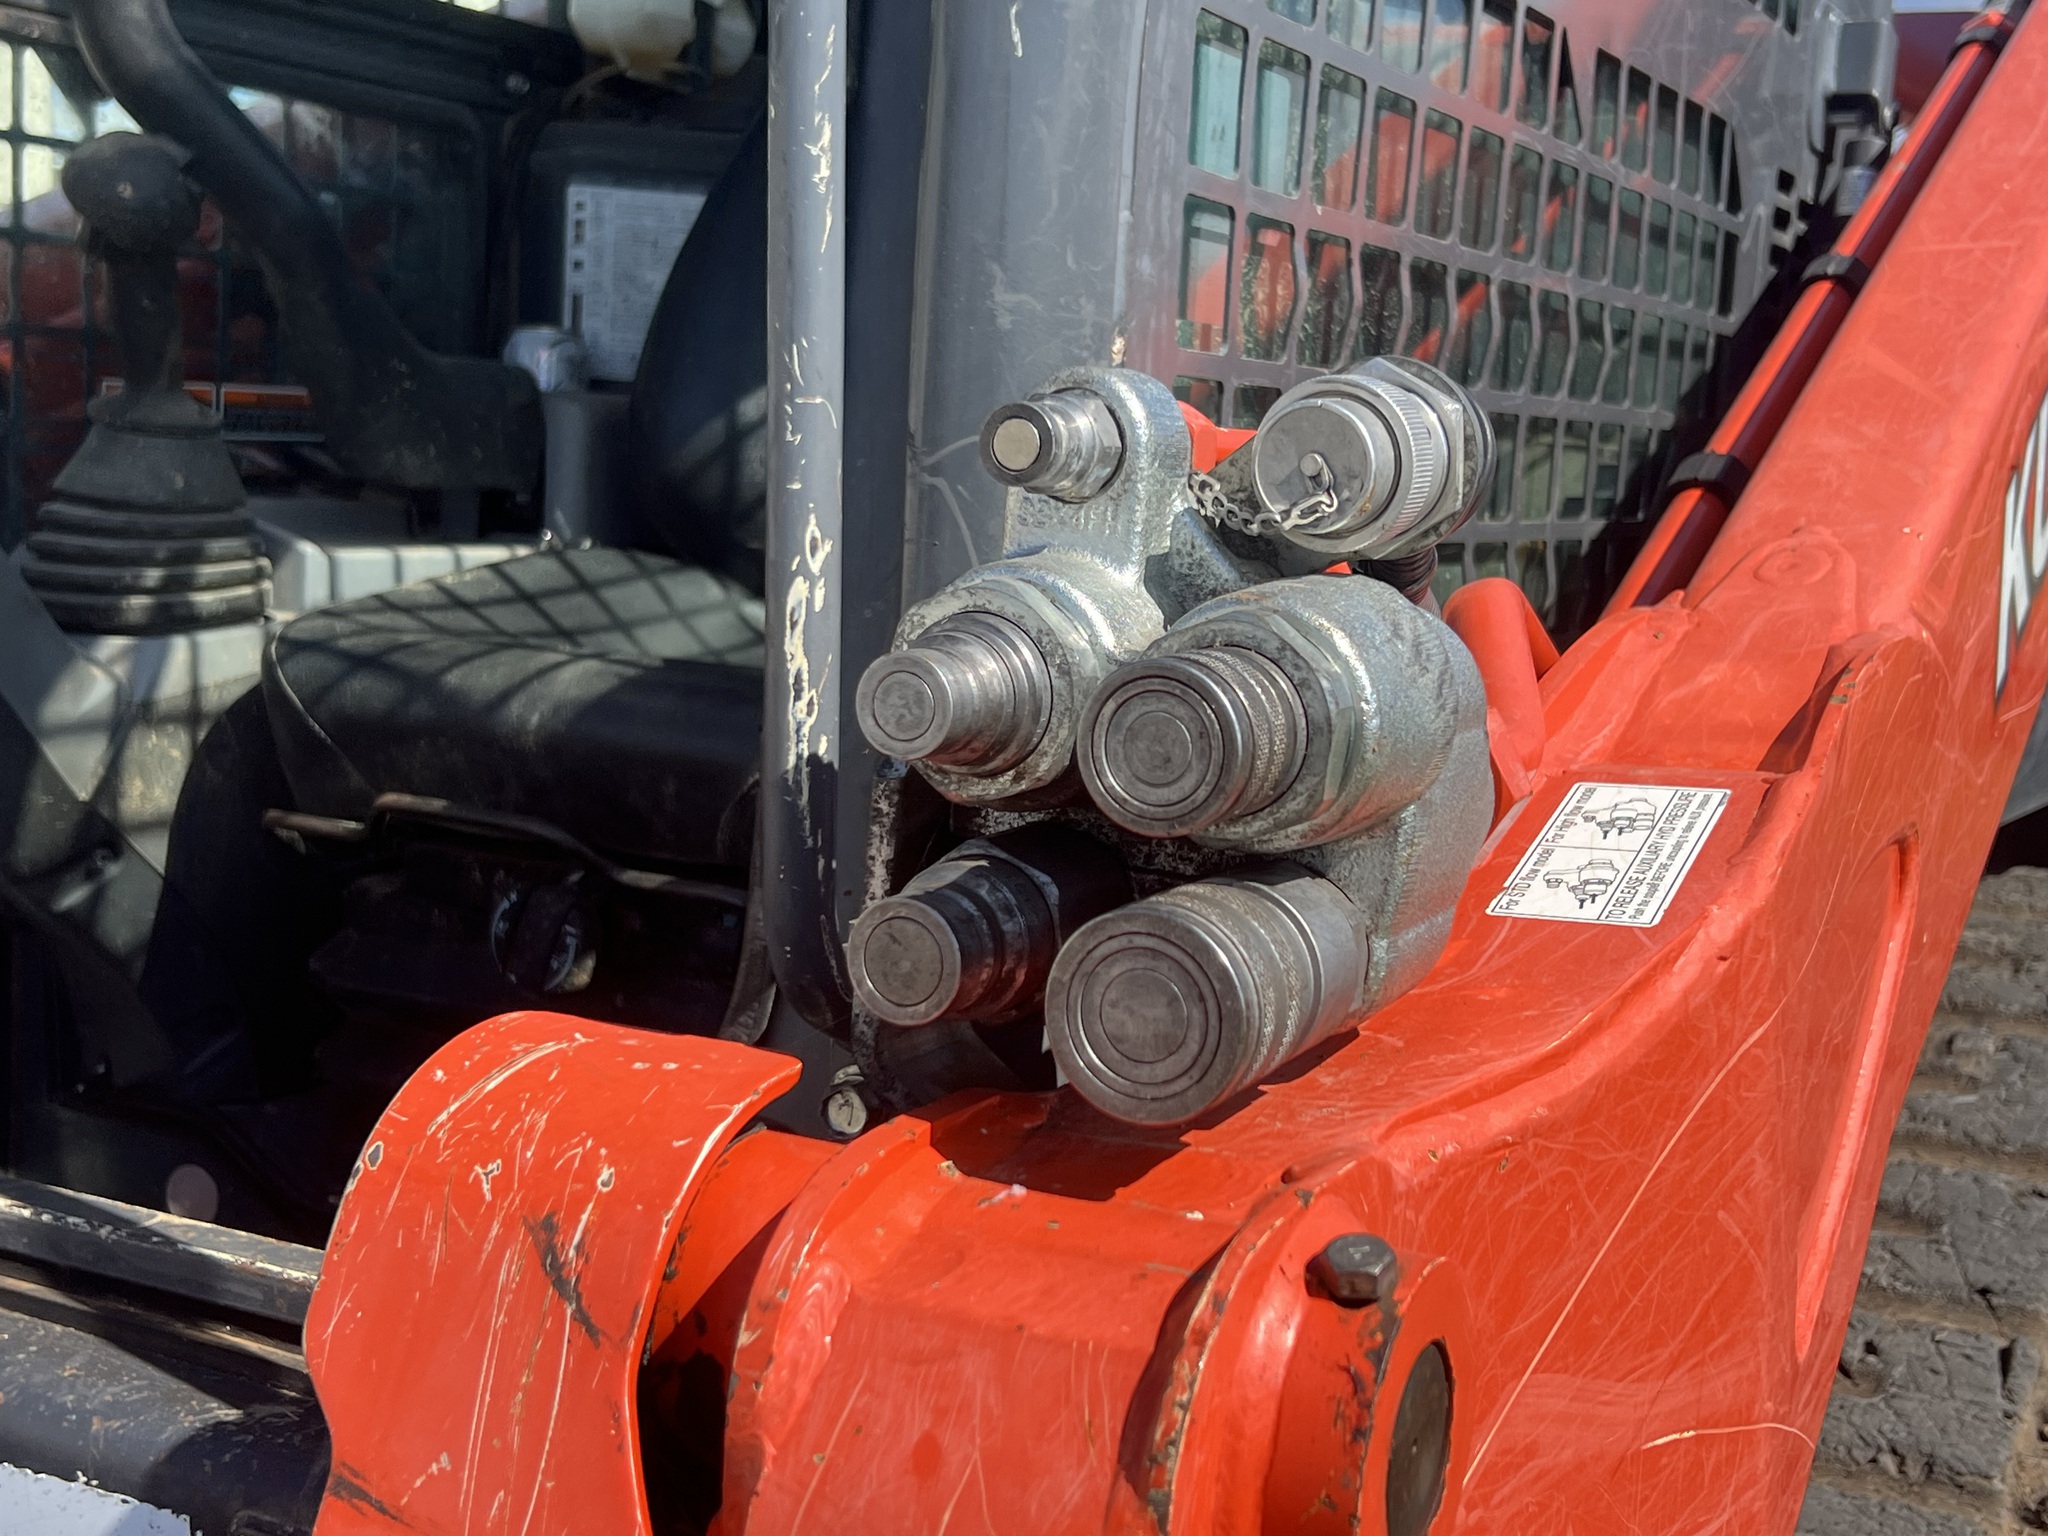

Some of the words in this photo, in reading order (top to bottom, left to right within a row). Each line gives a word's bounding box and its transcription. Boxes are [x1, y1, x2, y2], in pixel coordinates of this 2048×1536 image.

[1572, 787, 1596, 803] model
[1562, 805, 1584, 816] flow
[1662, 791, 1697, 825] PRESSURE
[1552, 818, 1579, 832] High
[1544, 832, 1566, 843] For
[1653, 826, 1676, 839] HYD
[1528, 848, 1555, 867] model
[1631, 841, 1667, 874] AUXILIARY
[1518, 868, 1541, 881] flow
[1650, 862, 1672, 881] BEFORE
[1507, 882, 1532, 897] STD
[1611, 876, 1646, 907] RELEASE
[1499, 898, 1520, 910] For
[1605, 908, 1627, 919] TO
